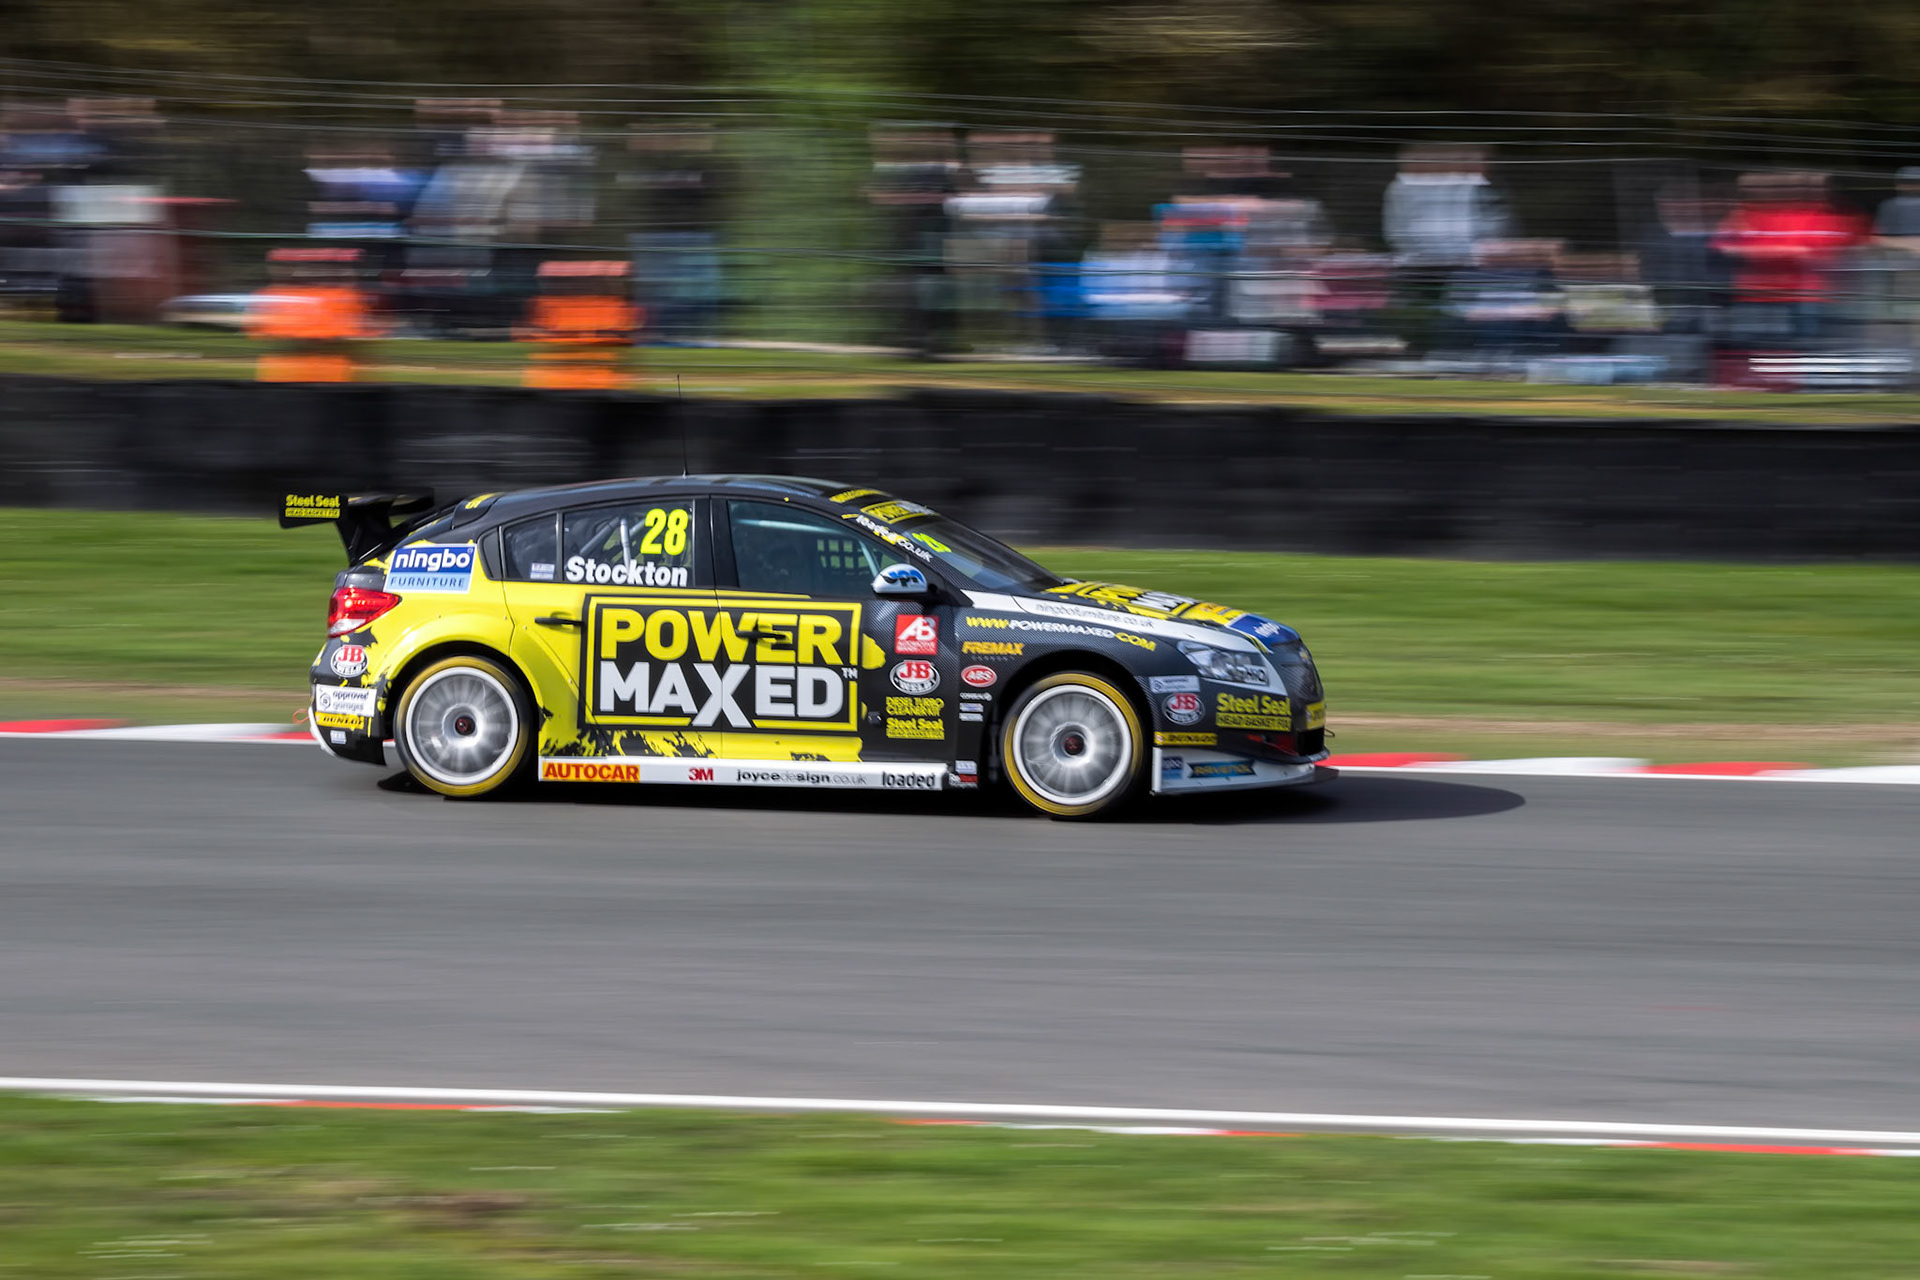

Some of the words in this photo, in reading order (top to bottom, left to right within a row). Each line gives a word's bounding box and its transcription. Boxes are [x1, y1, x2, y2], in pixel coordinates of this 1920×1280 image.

[286, 494, 315, 507] Steel
[315, 495, 340, 508] Seal
[640, 508, 689, 556] 28
[395, 548, 471, 572] ningbo
[565, 555, 688, 588] Stockton
[390, 576, 465, 588] FURNITURE
[600, 608, 843, 665] POWER
[961, 641, 1024, 656] FREMAX
[600, 660, 844, 728] MAXED
[1216, 692, 1260, 714] Steel
[1261, 695, 1292, 717] Seal
[886, 717, 917, 730] Steel
[917, 718, 945, 731] Seal
[544, 763, 640, 781] AUTOCAR
[688, 767, 714, 781] 3M
[882, 771, 936, 788] loaded
